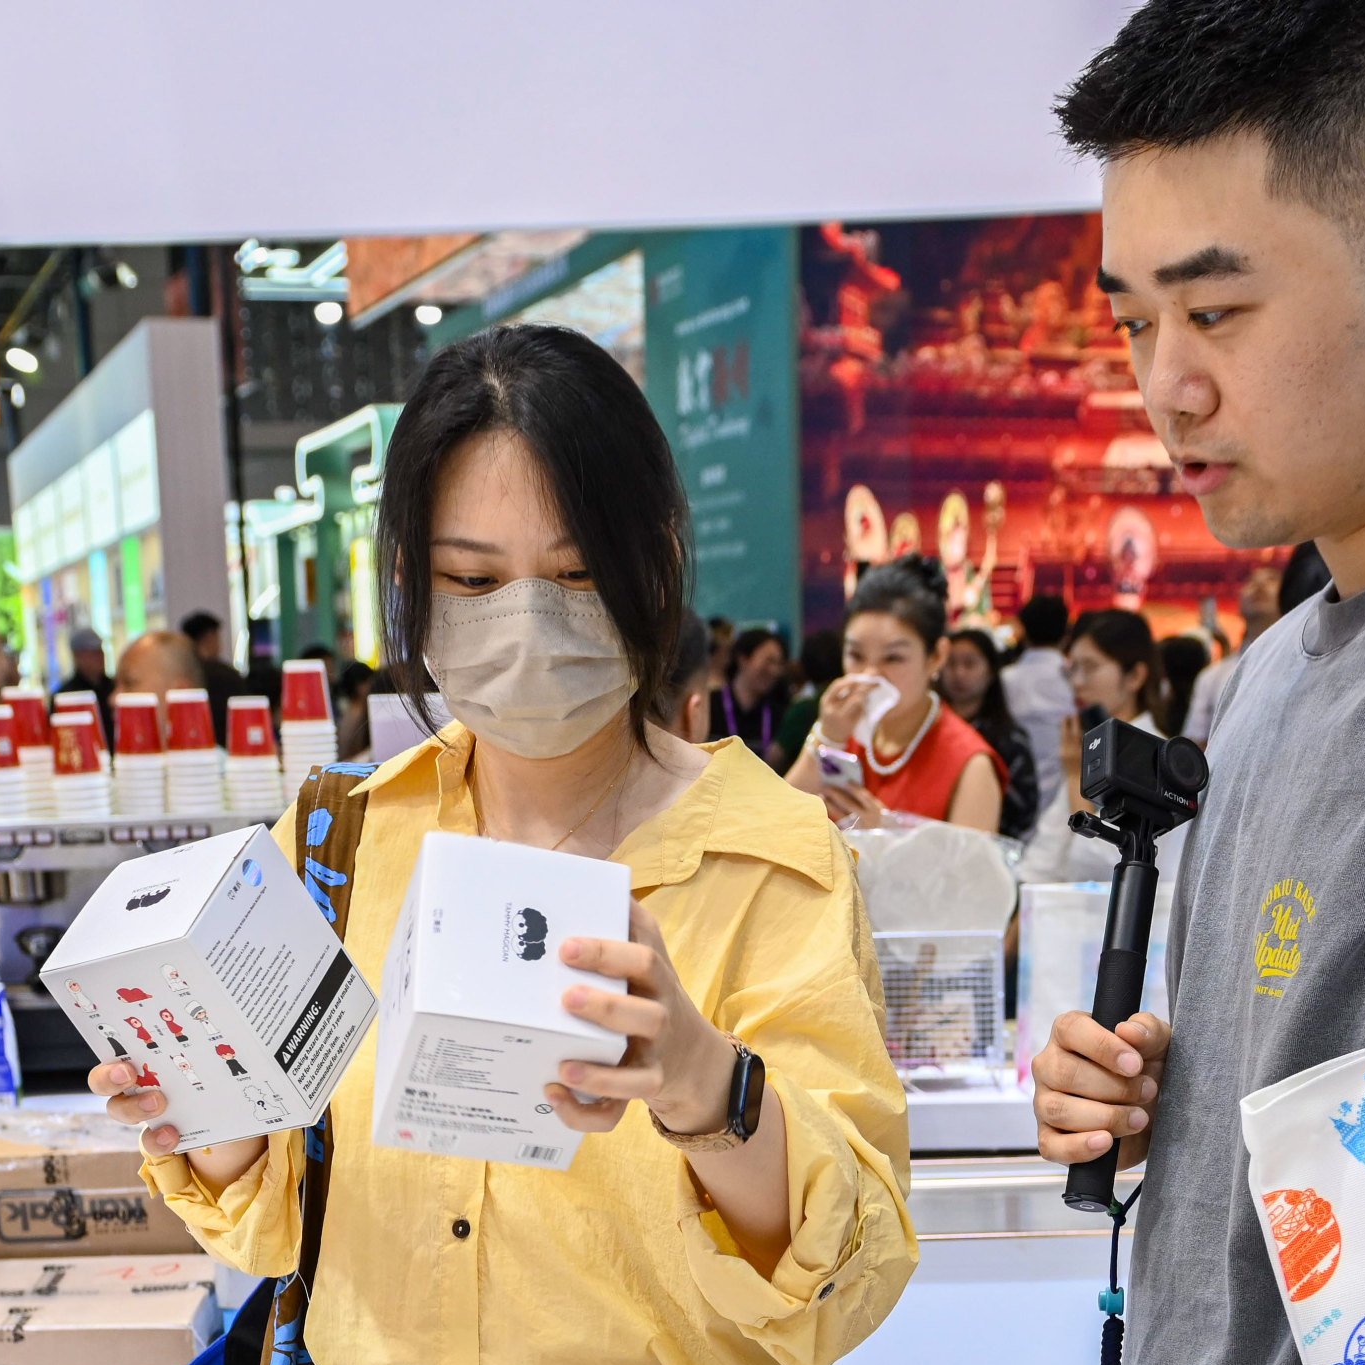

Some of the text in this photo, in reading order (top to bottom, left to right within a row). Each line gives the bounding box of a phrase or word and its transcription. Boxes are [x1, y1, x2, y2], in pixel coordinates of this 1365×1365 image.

[1164, 790, 1189, 806] ACTION
[1253, 932, 1302, 974] Update
[285, 999, 322, 1056] WARNING:
[291, 971, 356, 1079] Choking hazard small parts and small ball.
[297, 1006, 346, 1085] Not for children under 3 years.
[302, 1031, 340, 1093] This is collectible item.
[308, 1059, 334, 1102] Recommended
[330, 1051, 338, 1064] for
[335, 1039, 346, 1057] ages
